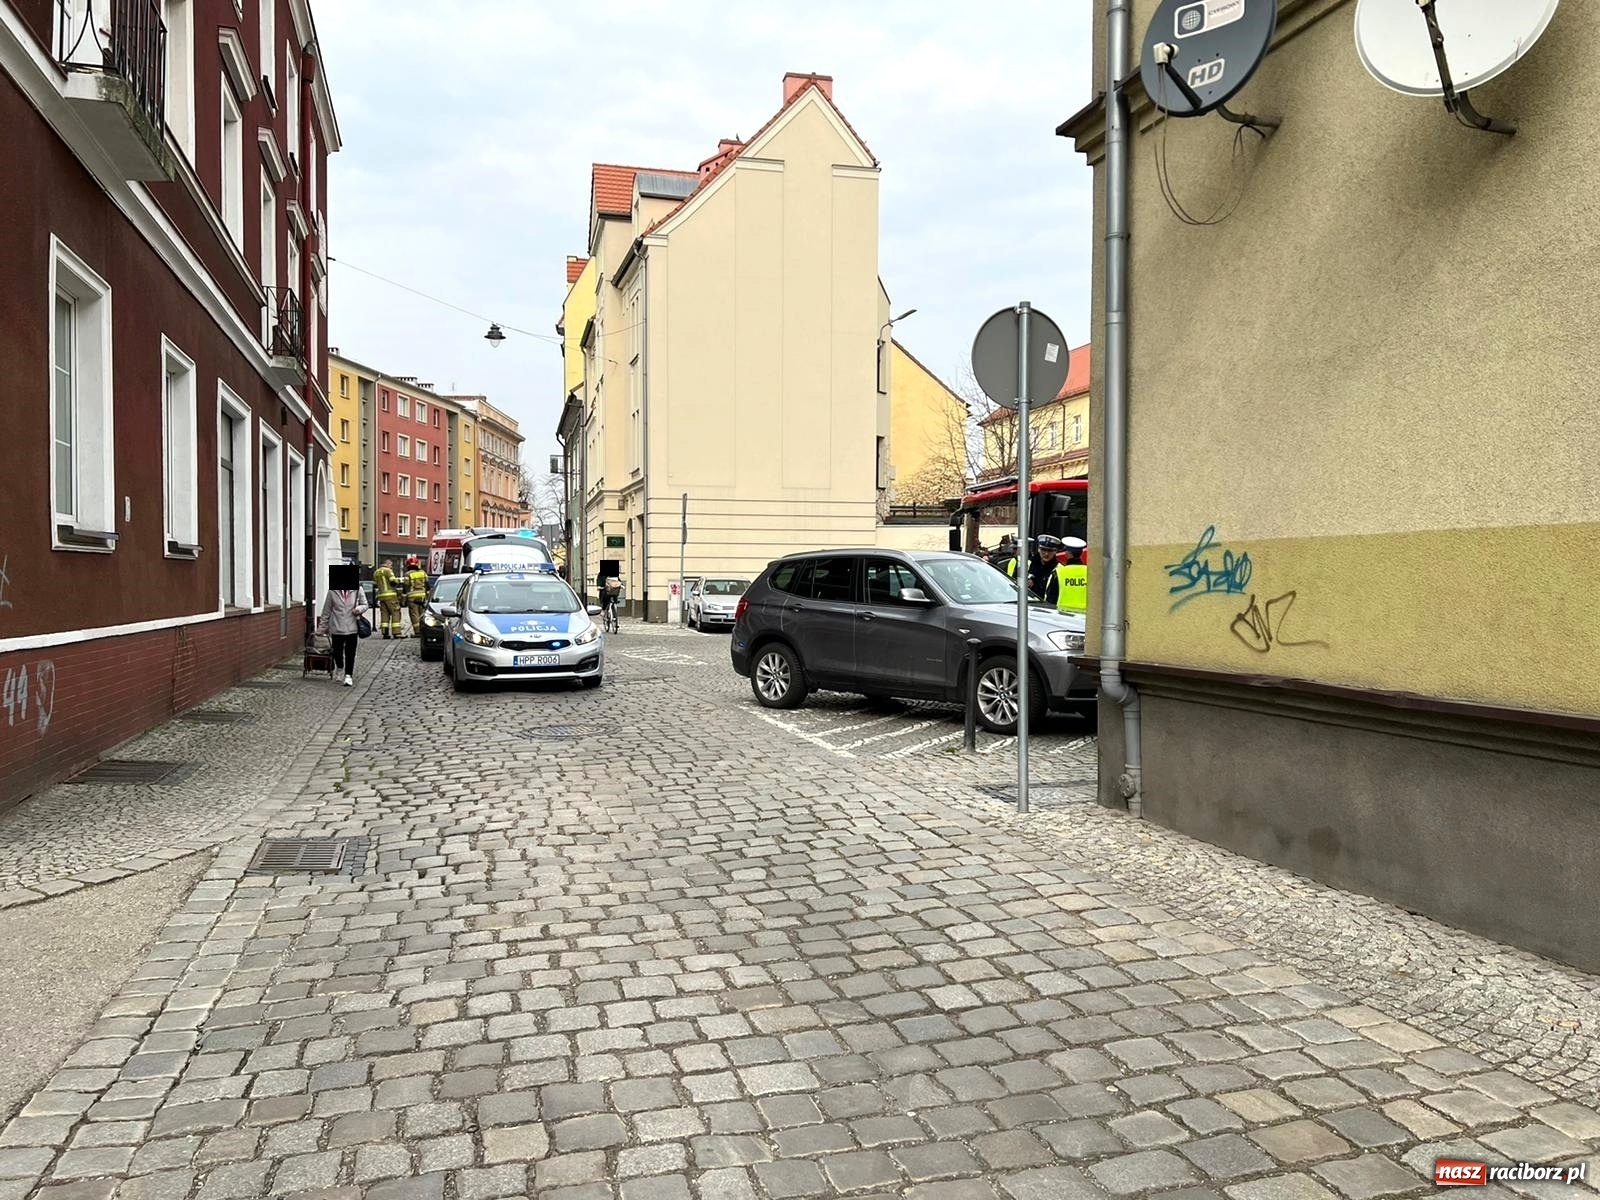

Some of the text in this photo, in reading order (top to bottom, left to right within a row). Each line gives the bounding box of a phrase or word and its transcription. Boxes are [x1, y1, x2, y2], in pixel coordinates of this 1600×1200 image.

[1190, 62, 1222, 87] HD
[511, 625, 558, 633] POLICJA
[519, 655, 558, 664] HPP R006
